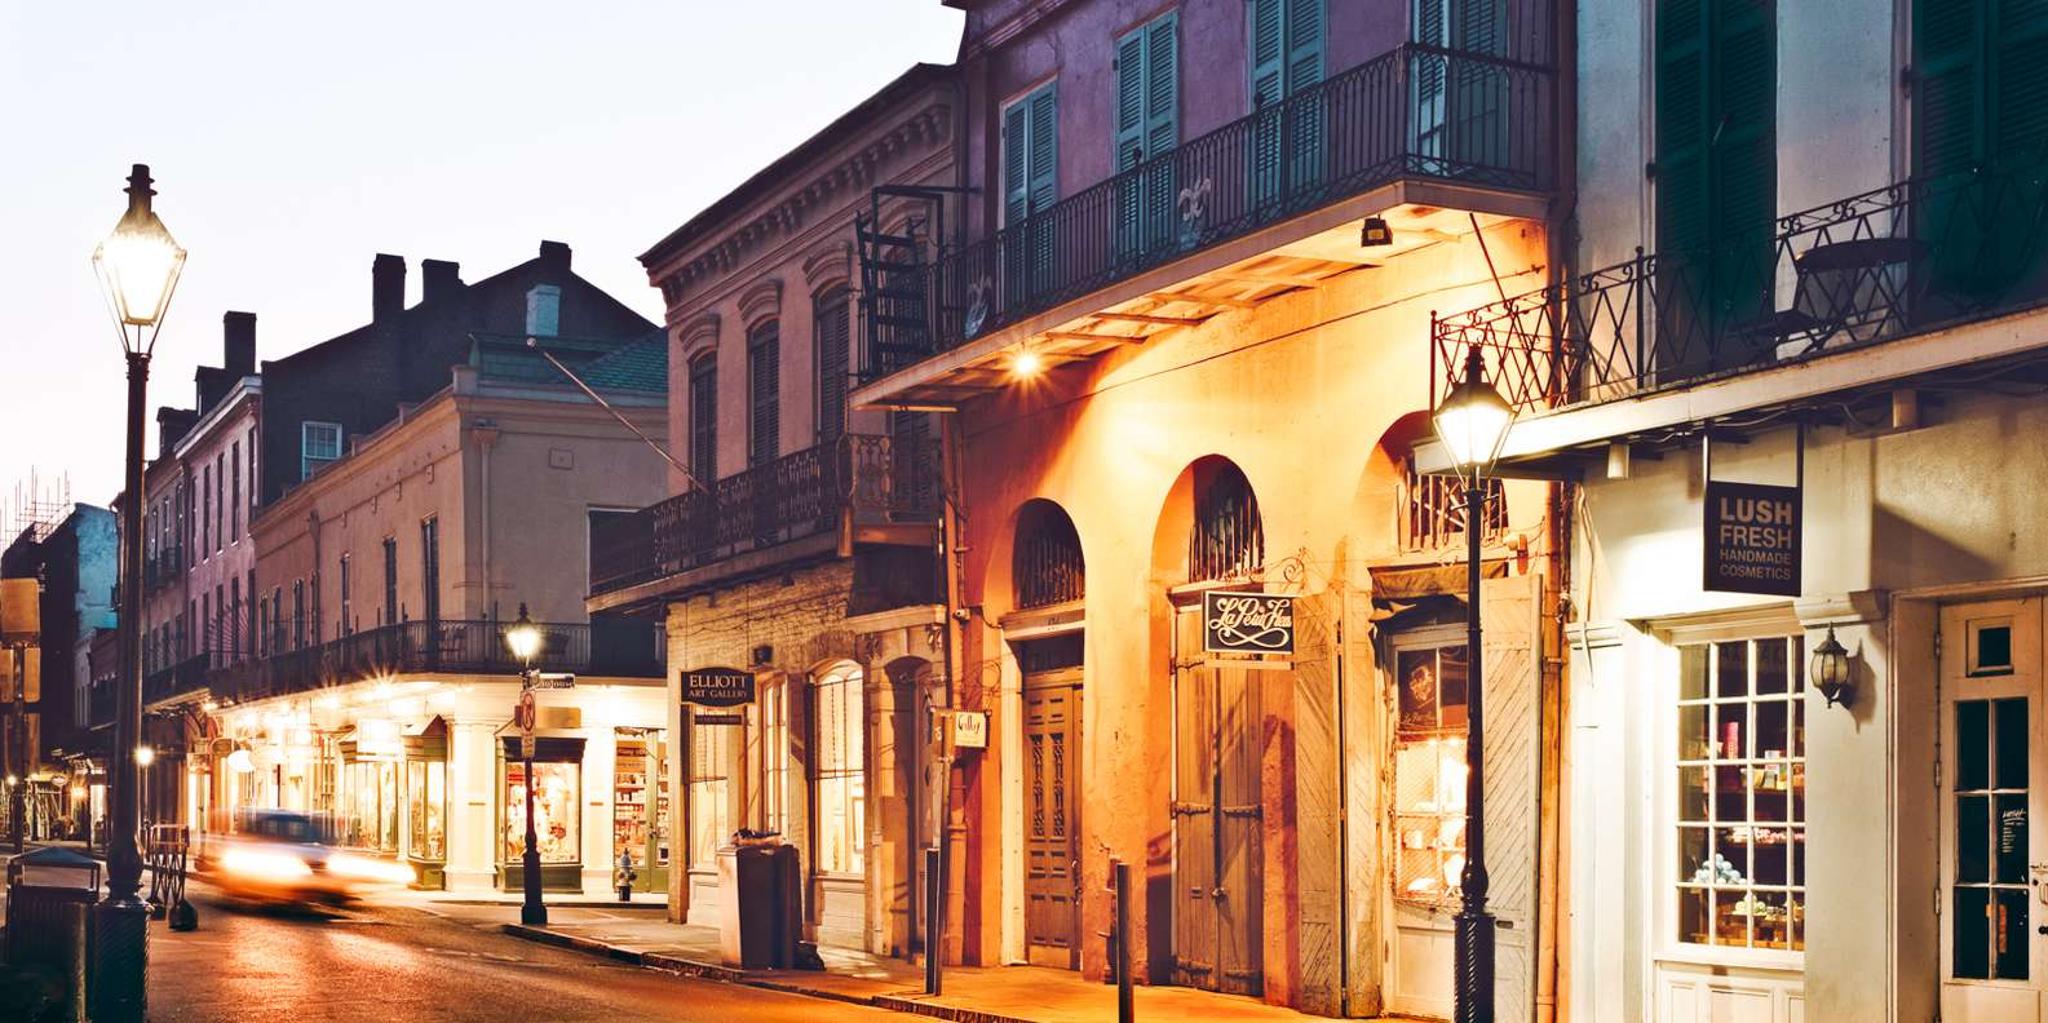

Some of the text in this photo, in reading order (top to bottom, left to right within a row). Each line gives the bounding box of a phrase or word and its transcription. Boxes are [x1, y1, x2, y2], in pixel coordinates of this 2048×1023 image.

[1720, 496, 1792, 525] LUSH
[1720, 524, 1792, 549] FRESH
[1720, 549, 1792, 565] HANDMADE
[1720, 564, 1792, 580] COSMETICS
[1209, 598, 1239, 629] La
[689, 675, 748, 688] ELLIOTT
[688, 689, 747, 698] ART GALLERY
